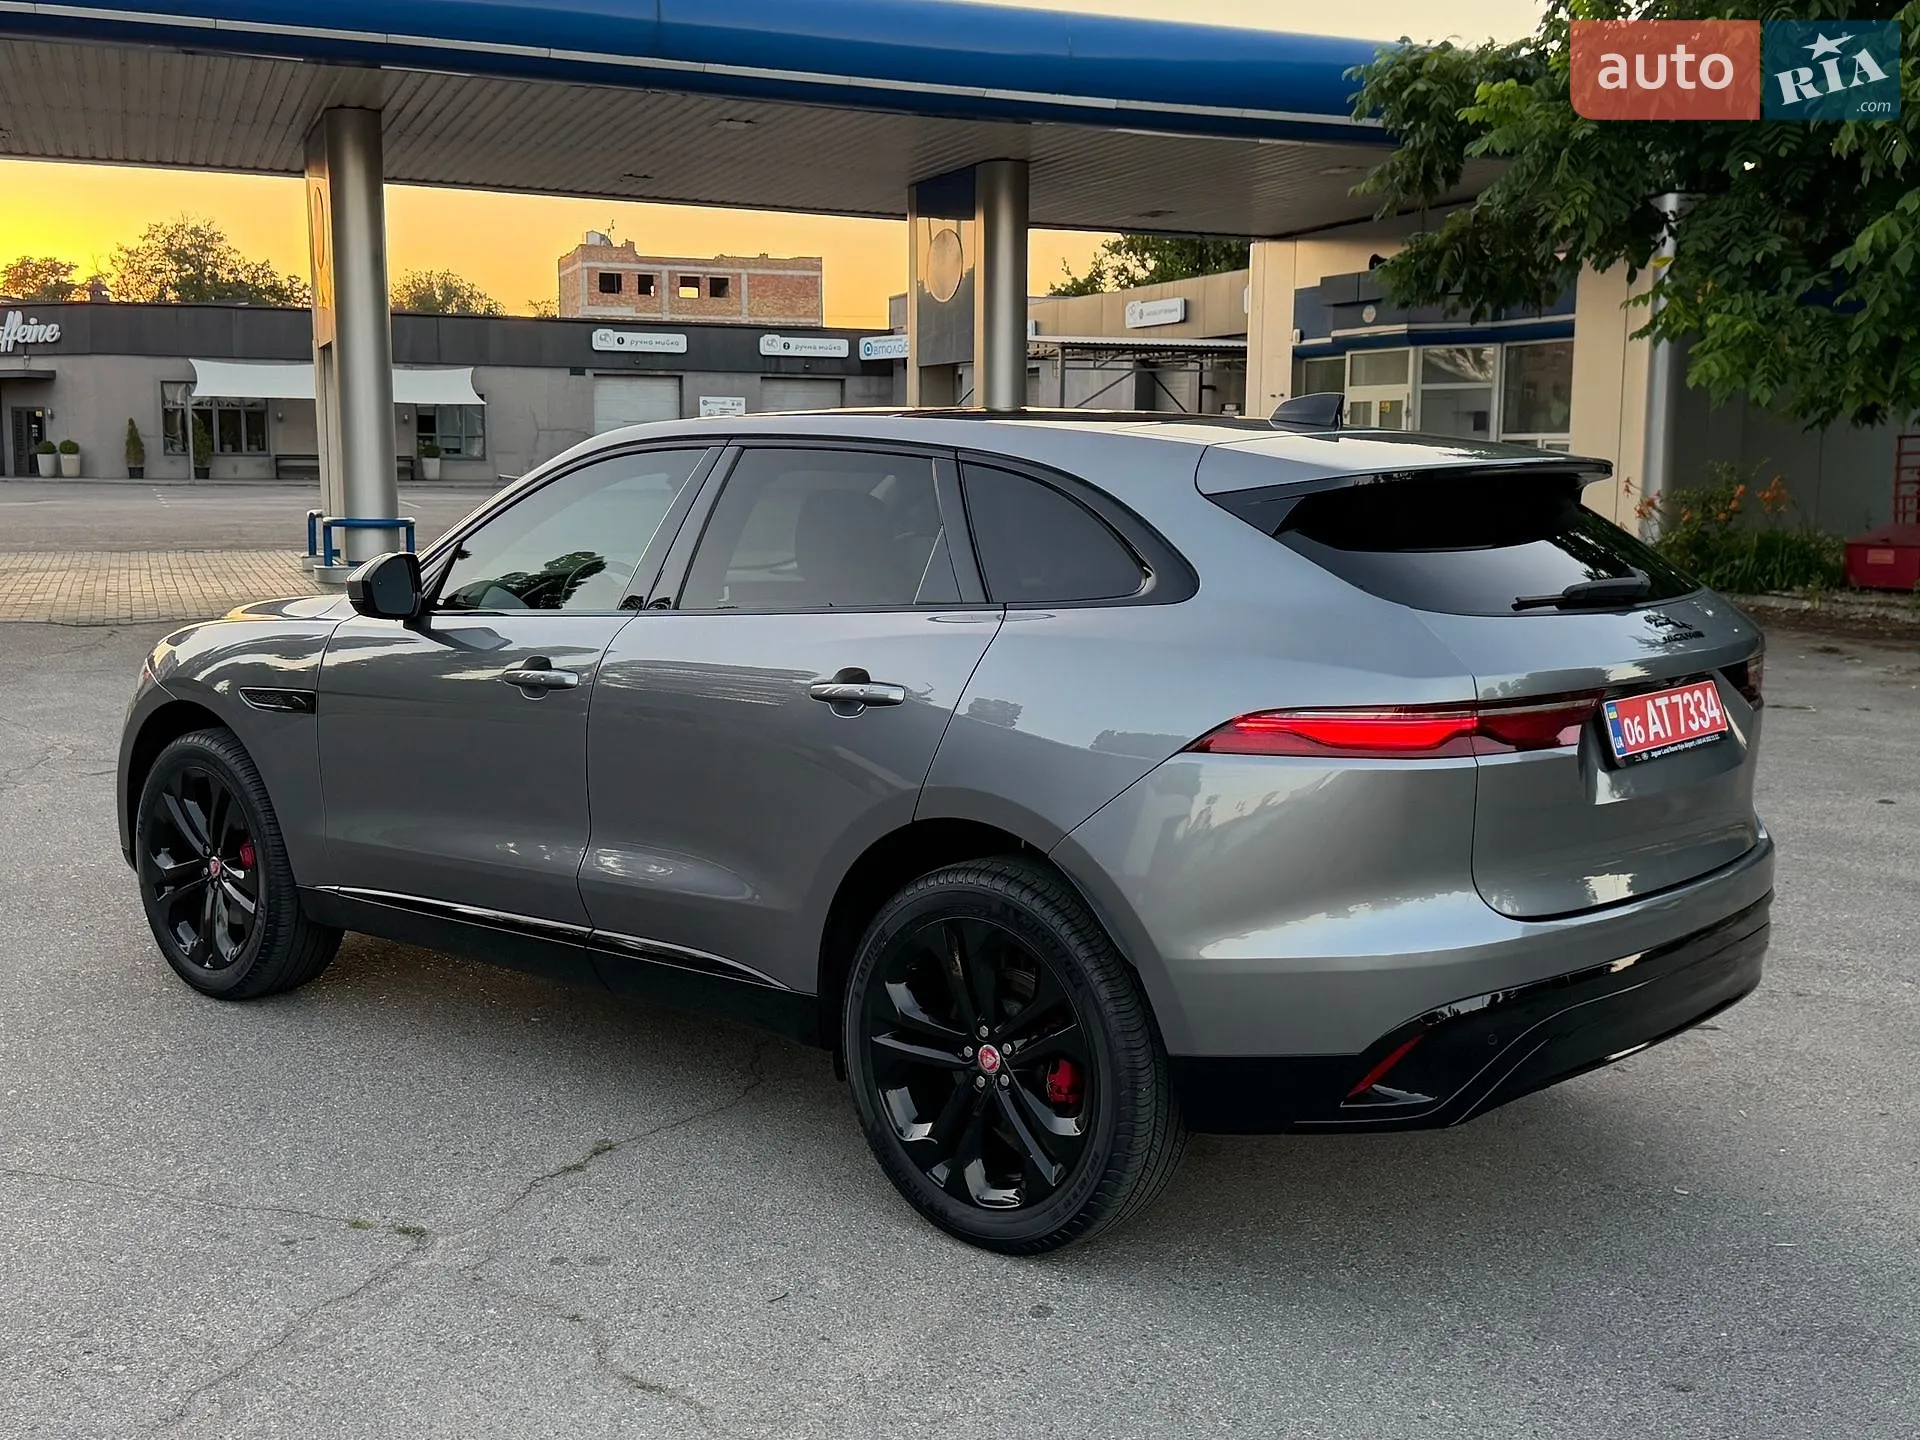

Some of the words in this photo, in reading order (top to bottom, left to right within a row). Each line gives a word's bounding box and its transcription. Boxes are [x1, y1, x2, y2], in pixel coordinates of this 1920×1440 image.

[0, 310, 61, 352] ffeine
[1623, 715, 1646, 746] 06
[1645, 696, 1673, 742] AT
[1670, 687, 1721, 734] 7334
[1614, 736, 1625, 749] UA
